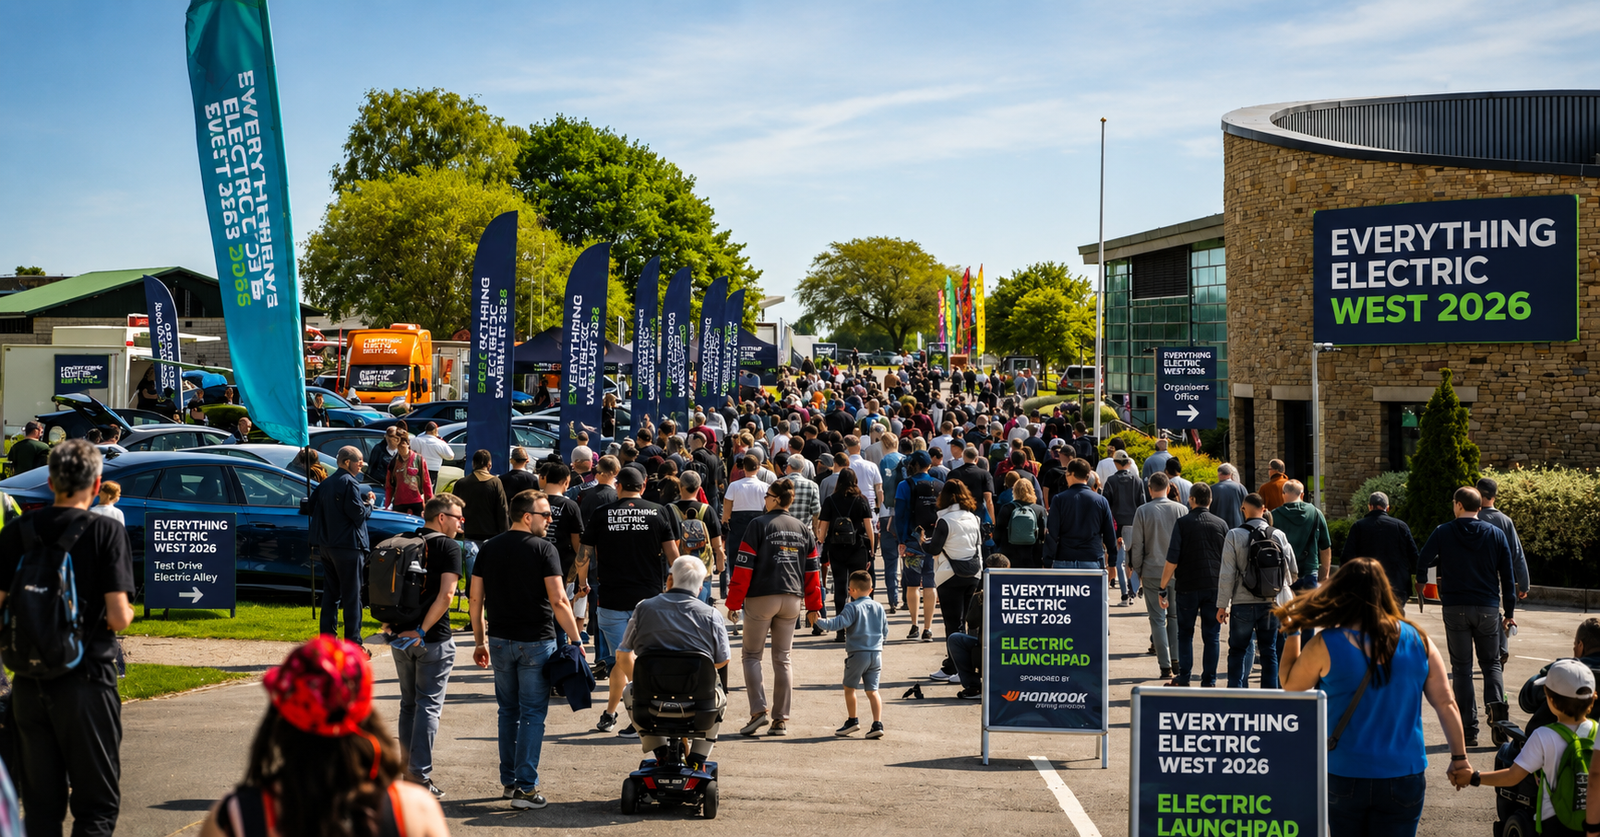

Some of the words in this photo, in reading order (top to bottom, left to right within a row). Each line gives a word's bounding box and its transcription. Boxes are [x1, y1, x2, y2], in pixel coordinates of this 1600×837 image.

[1331, 218, 1557, 256] EVERYTHING
[1331, 256, 1489, 290] ELECTRIC
[1331, 294, 1428, 325] WEST
[1437, 291, 1532, 322] 2026
[1174, 393, 1199, 401] Office
[154, 520, 228, 530] EVERYTHING
[154, 531, 208, 541] ELECTRIC
[154, 543, 187, 553] WEST
[189, 543, 217, 553] 2026
[154, 561, 175, 570] Test
[177, 561, 203, 570] Drive
[154, 572, 191, 582] Electric
[193, 572, 218, 583] Alley
[1001, 584, 1091, 597] EVERYTHING
[1001, 598, 1067, 611] ELECTRIC
[1001, 613, 1038, 624] WEST
[1041, 613, 1072, 625] 2026
[1001, 637, 1074, 651] ELECTRIC
[1001, 652, 1091, 667] LAUNCHPAD
[1158, 712, 1299, 732] EVERYTHING
[1158, 734, 1261, 753] ELECTRIC
[1158, 756, 1217, 773] WEST
[1222, 757, 1270, 775] 2026
[1157, 793, 1272, 814] ELECTRIC
[1157, 817, 1299, 837] LAUNCHPAD
